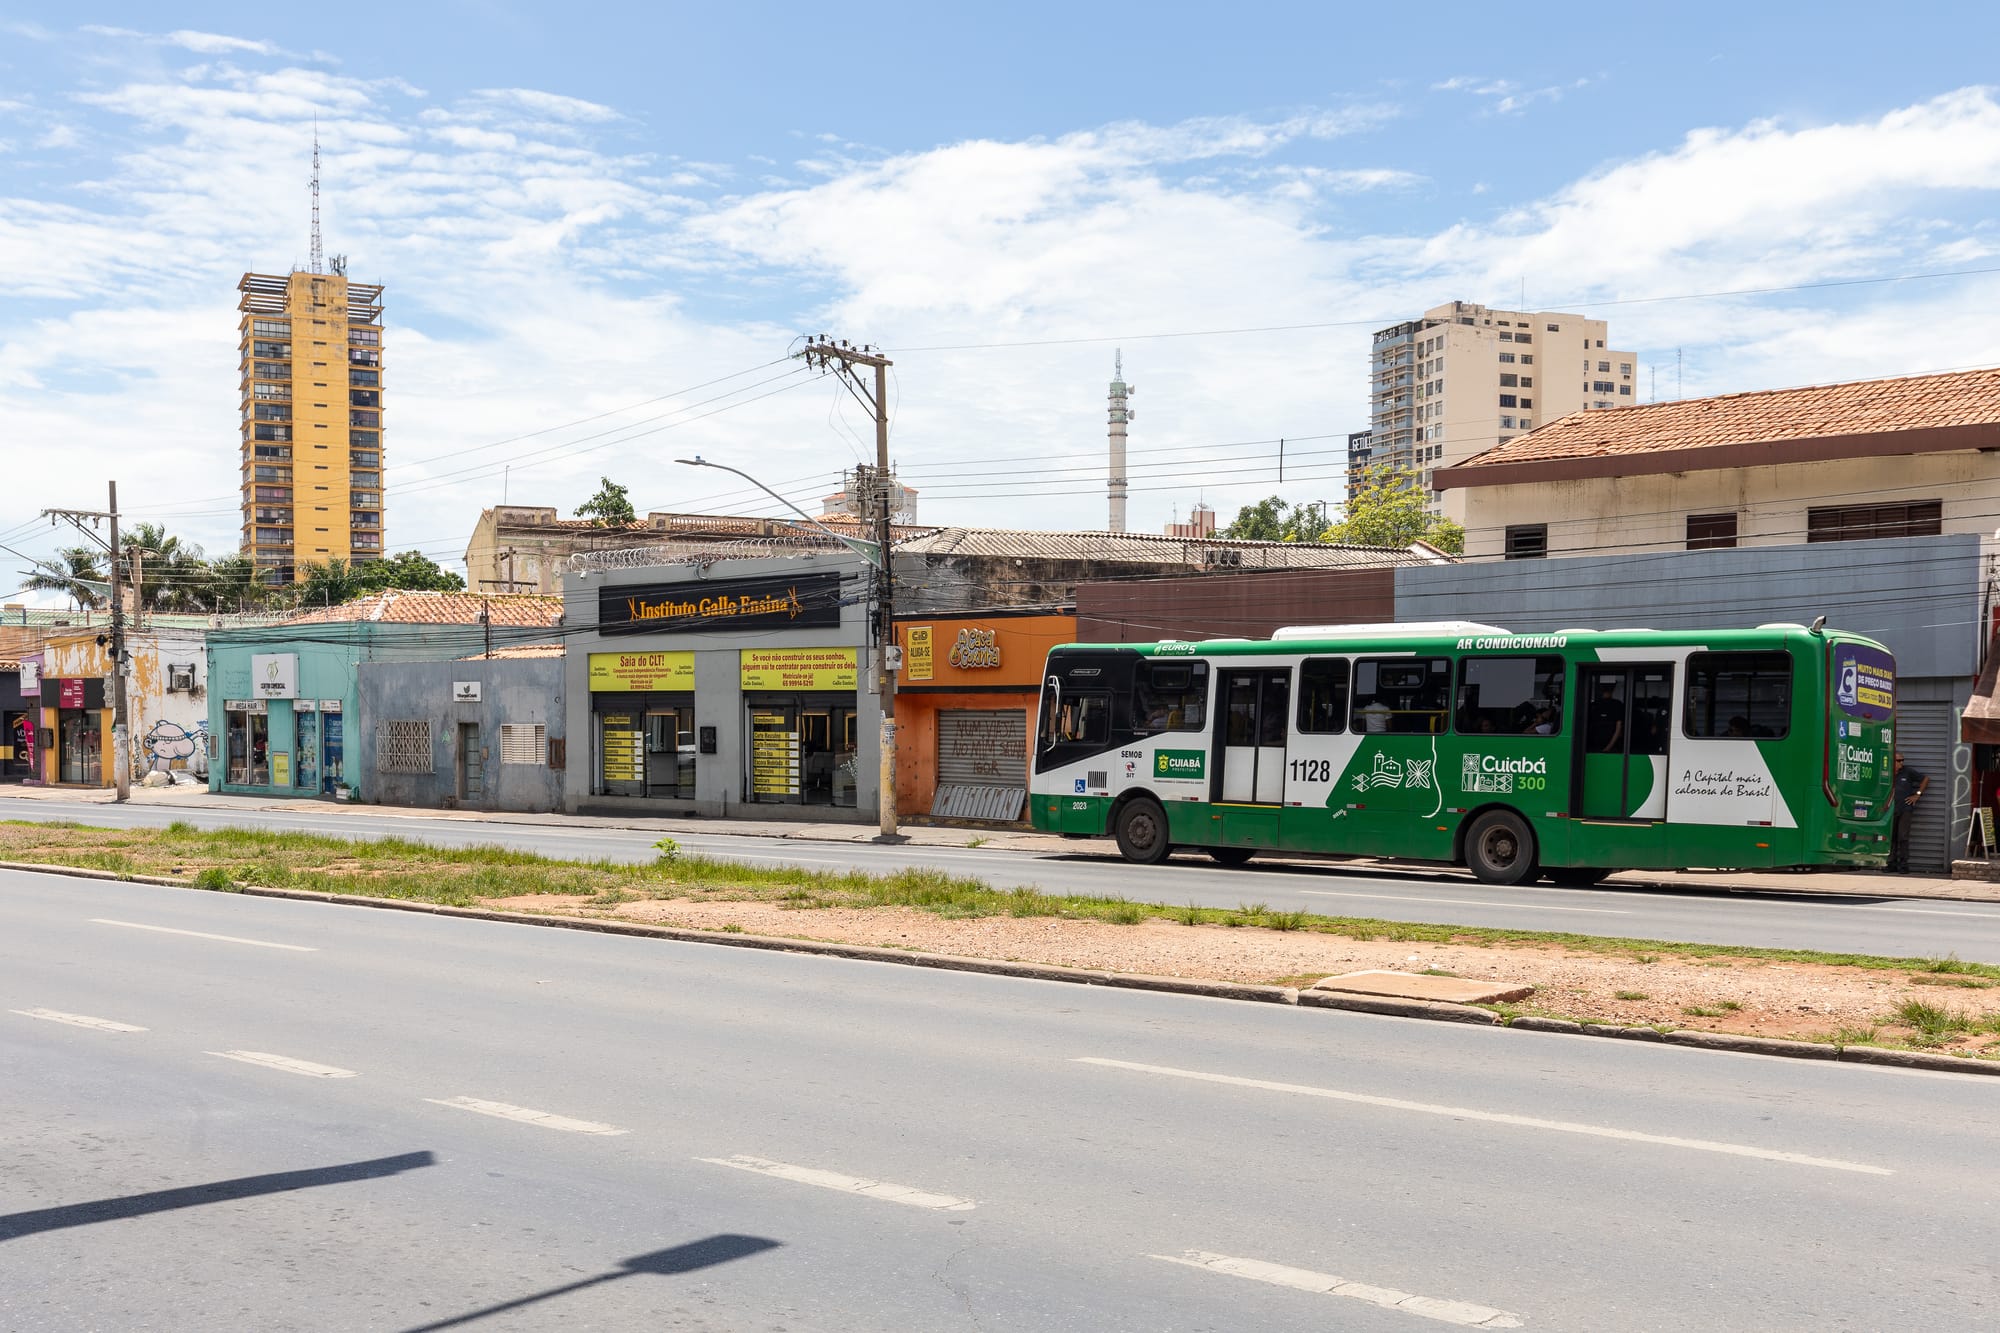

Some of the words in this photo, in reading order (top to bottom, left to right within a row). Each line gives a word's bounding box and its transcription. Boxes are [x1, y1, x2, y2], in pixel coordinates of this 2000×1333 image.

[640, 600, 696, 619] Instituto
[699, 595, 737, 616] Gallo
[740, 594, 788, 614] Ensina
[968, 631, 994, 649] Casa
[1456, 638, 1472, 649] AR
[1476, 636, 1567, 649] CONDICIONADO
[910, 647, 930, 657] ALUGA-SE
[1188, 645, 1197, 654] 5
[620, 656, 636, 667] Saia
[638, 656, 646, 666] do
[649, 654, 665, 666] CLT!
[782, 653, 805, 661] construir
[826, 652, 846, 660] sonhos,
[961, 648, 999, 666] Coxinha
[743, 663, 760, 672] alguém
[1858, 675, 1865, 684] DE
[1865, 676, 1879, 688] PREÇO
[1881, 728, 1892, 744] 1128
[1848, 745, 1873, 763] Cuiabá
[1169, 757, 1200, 768] CUIABÁ
[1482, 755, 1546, 774] Cuiabá
[1290, 760, 1330, 782] 1128
[1683, 770, 1691, 782] A
[1695, 770, 1733, 785] Capital
[1736, 774, 1761, 783] mais
[1861, 767, 1872, 779] 300
[1518, 777, 1546, 790] 300
[1675, 783, 1717, 795] calorosa
[1720, 785, 1733, 795] do
[1737, 785, 1770, 796] Brasil
[1072, 802, 1087, 810] 2023
